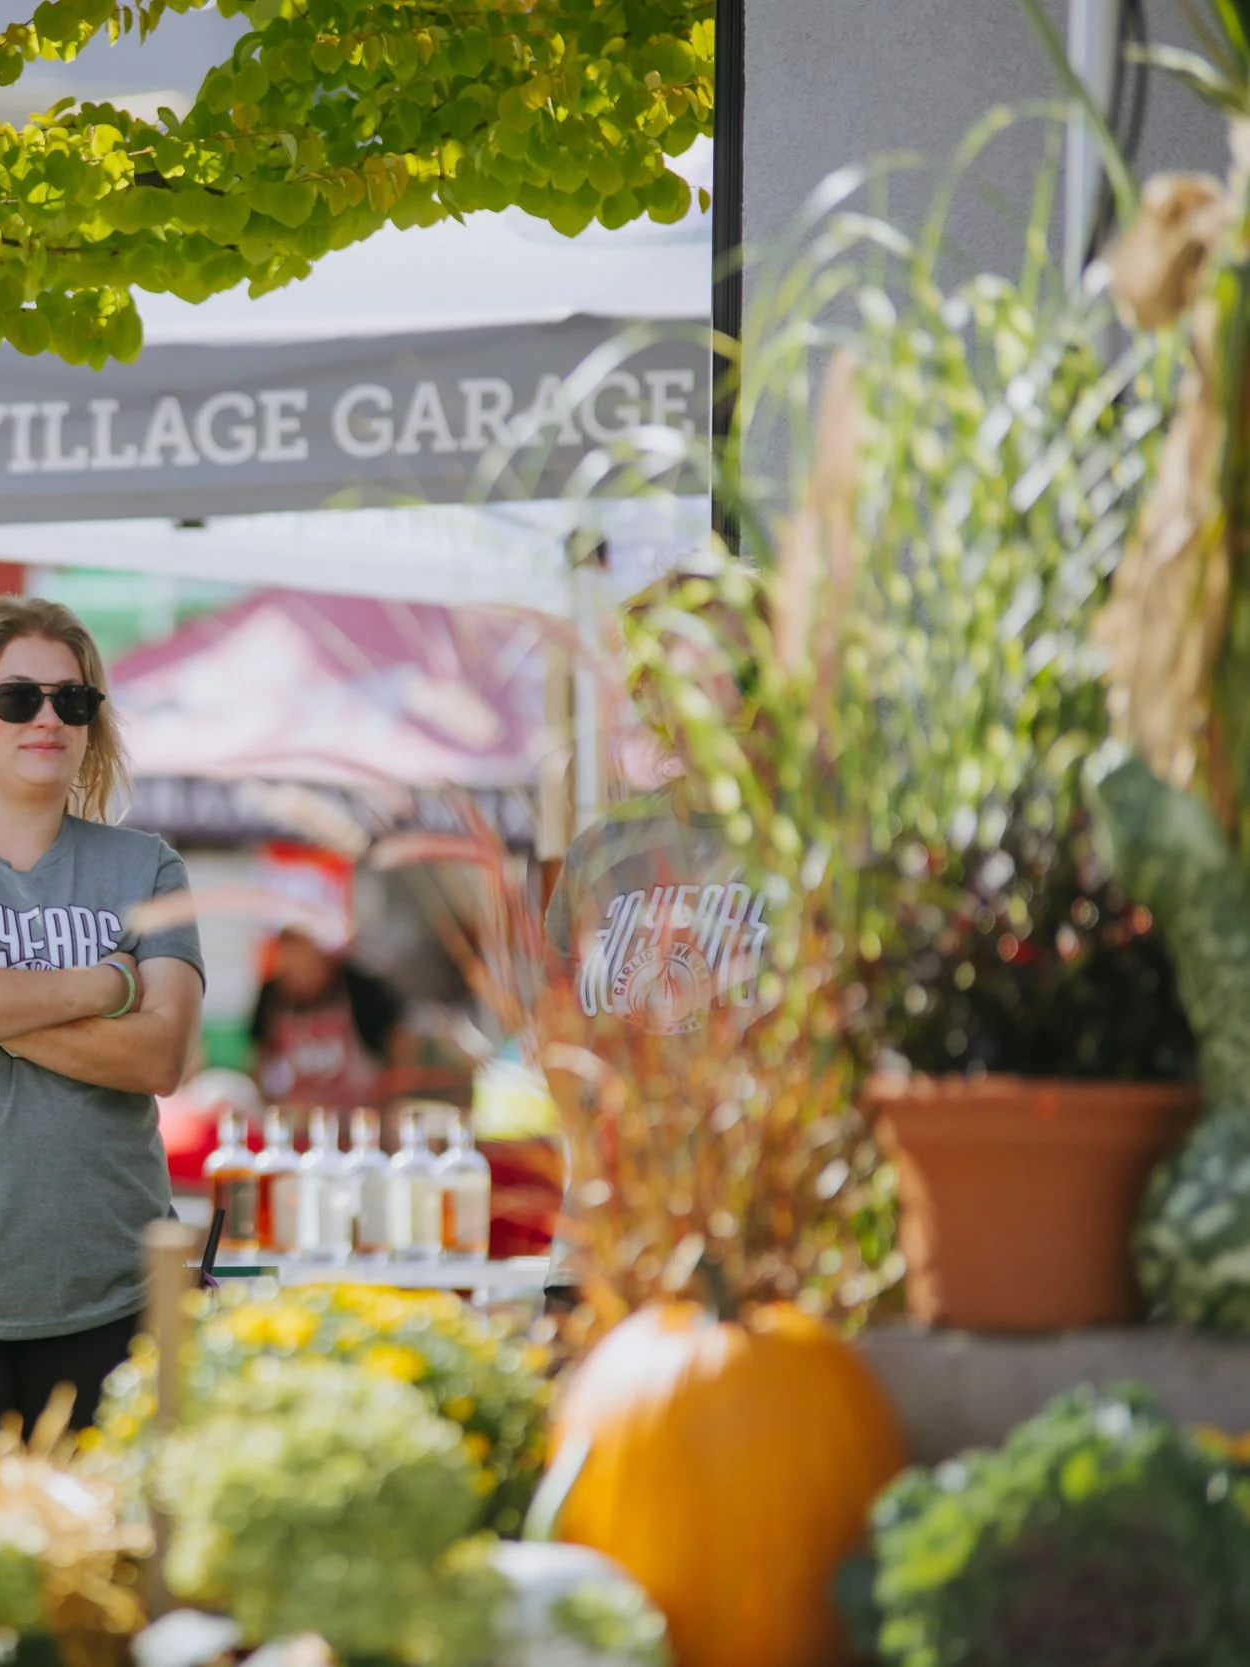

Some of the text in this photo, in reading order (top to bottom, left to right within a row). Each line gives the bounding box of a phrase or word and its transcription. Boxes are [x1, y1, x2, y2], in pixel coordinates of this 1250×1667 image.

[333, 370, 696, 457] GARAGE
[614, 950, 654, 996] GARLIC
[642, 881, 769, 1009] YEARS
